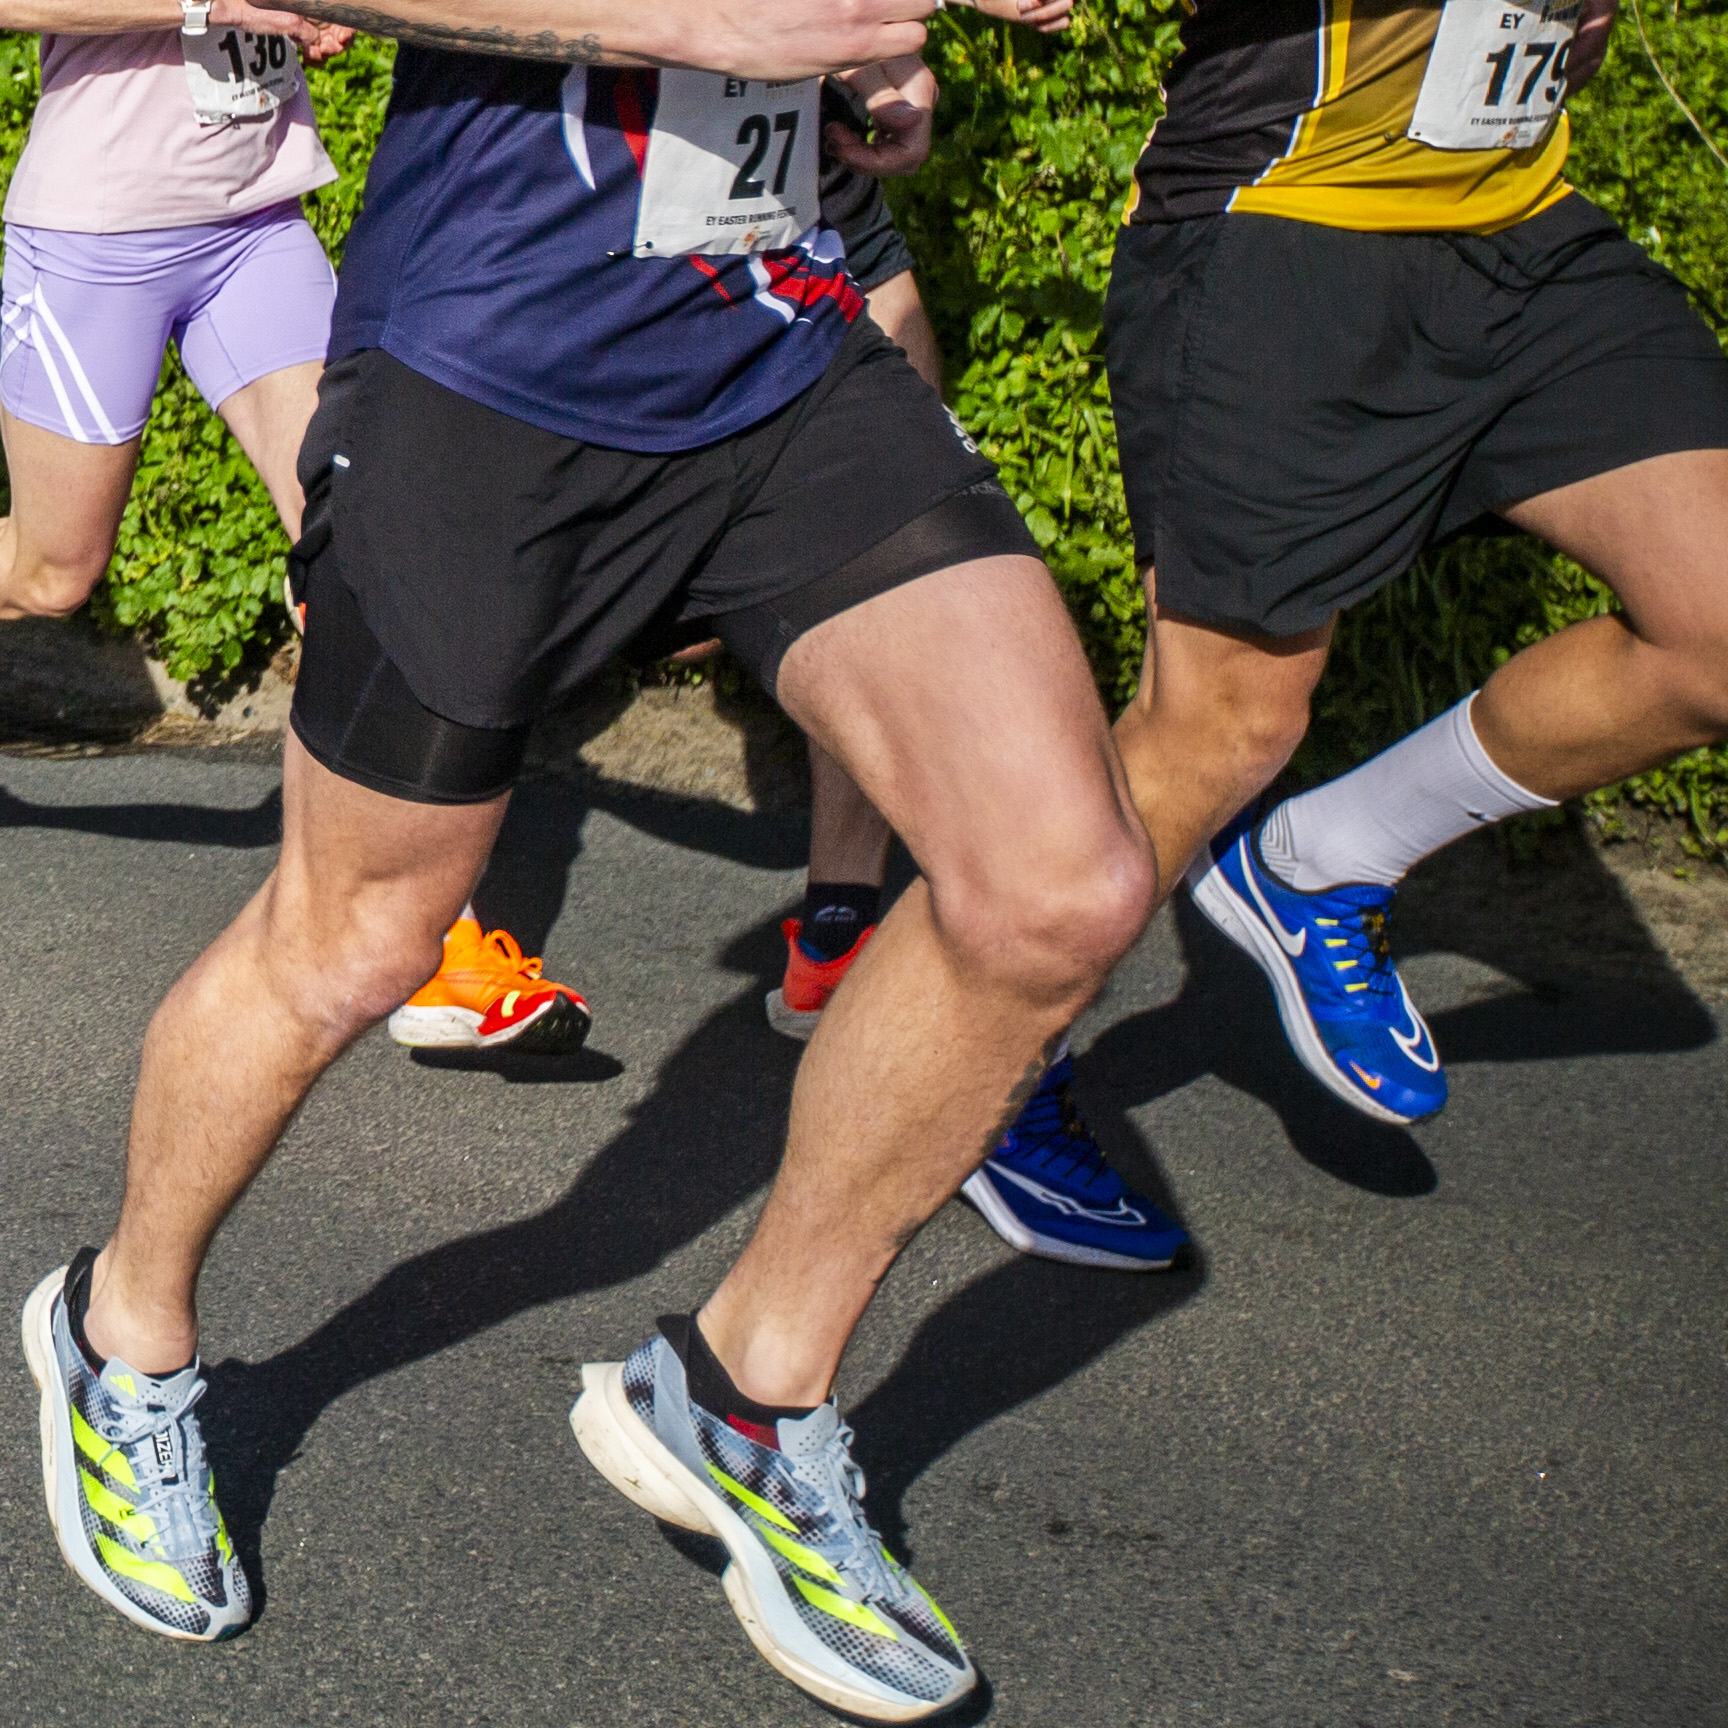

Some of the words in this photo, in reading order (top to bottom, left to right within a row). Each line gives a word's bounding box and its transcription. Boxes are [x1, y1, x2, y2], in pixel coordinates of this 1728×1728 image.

[1499, 13, 1526, 29] EY
[724, 77, 749, 98] EY
[728, 109, 800, 200] 27
[705, 215, 717, 226] EY
[718, 214, 747, 226] EASTER
[154, 1429, 174, 1467] IZE
